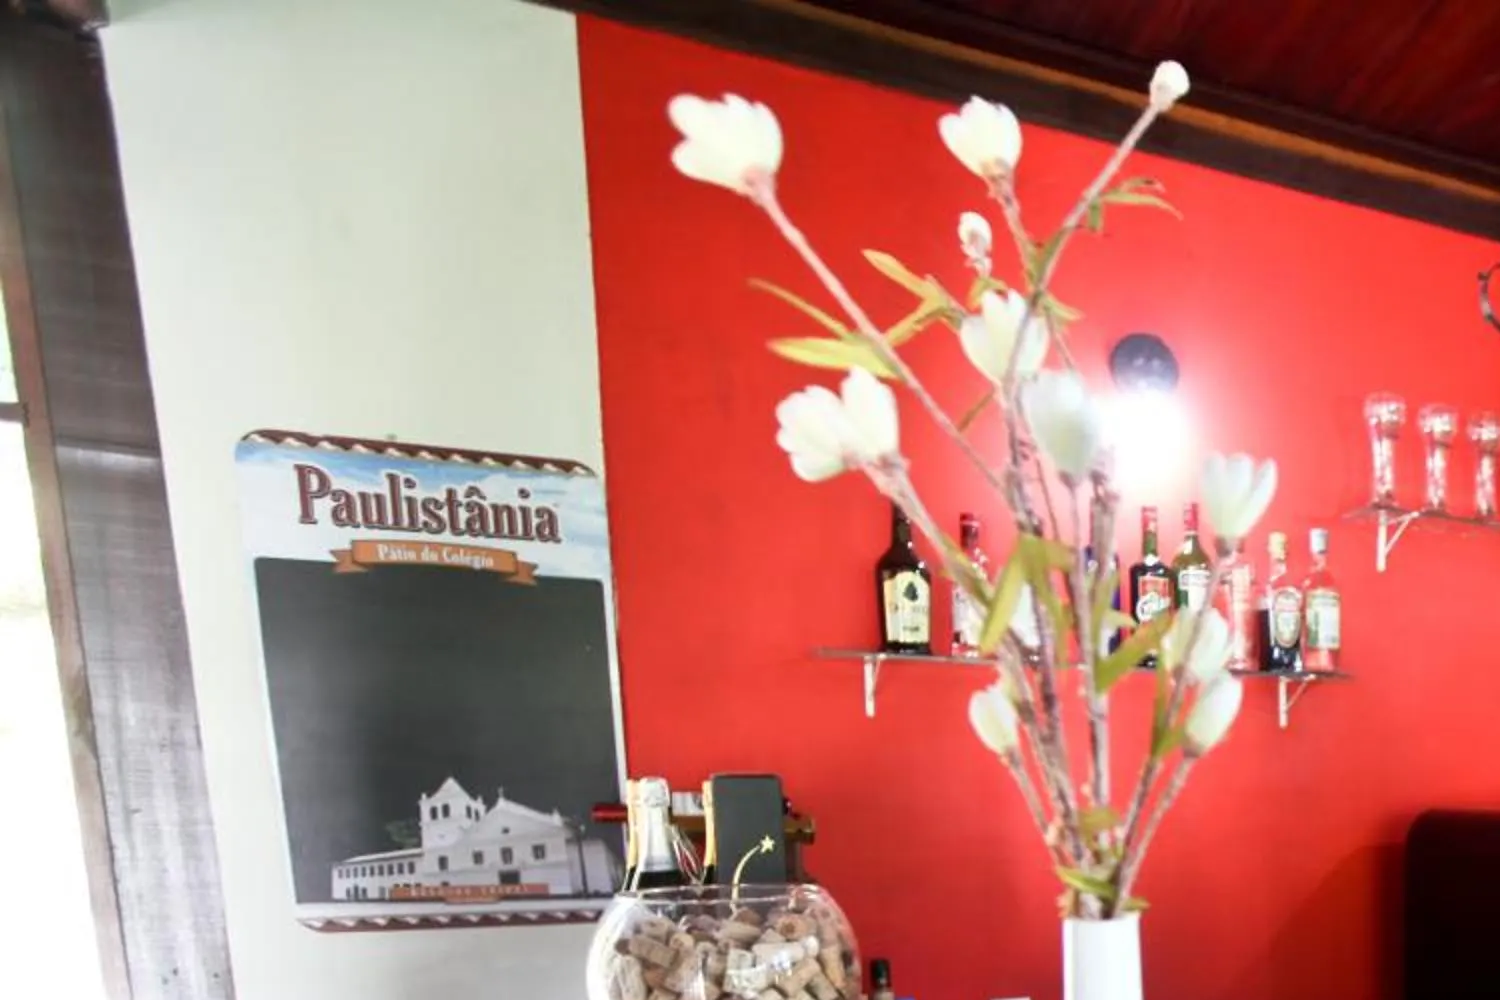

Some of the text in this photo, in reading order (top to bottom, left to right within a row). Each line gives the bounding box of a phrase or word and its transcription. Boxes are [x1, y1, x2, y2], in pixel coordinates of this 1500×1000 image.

[294, 464, 562, 543] Paulistânia
[376, 543, 495, 570] Pátio do Colégio
